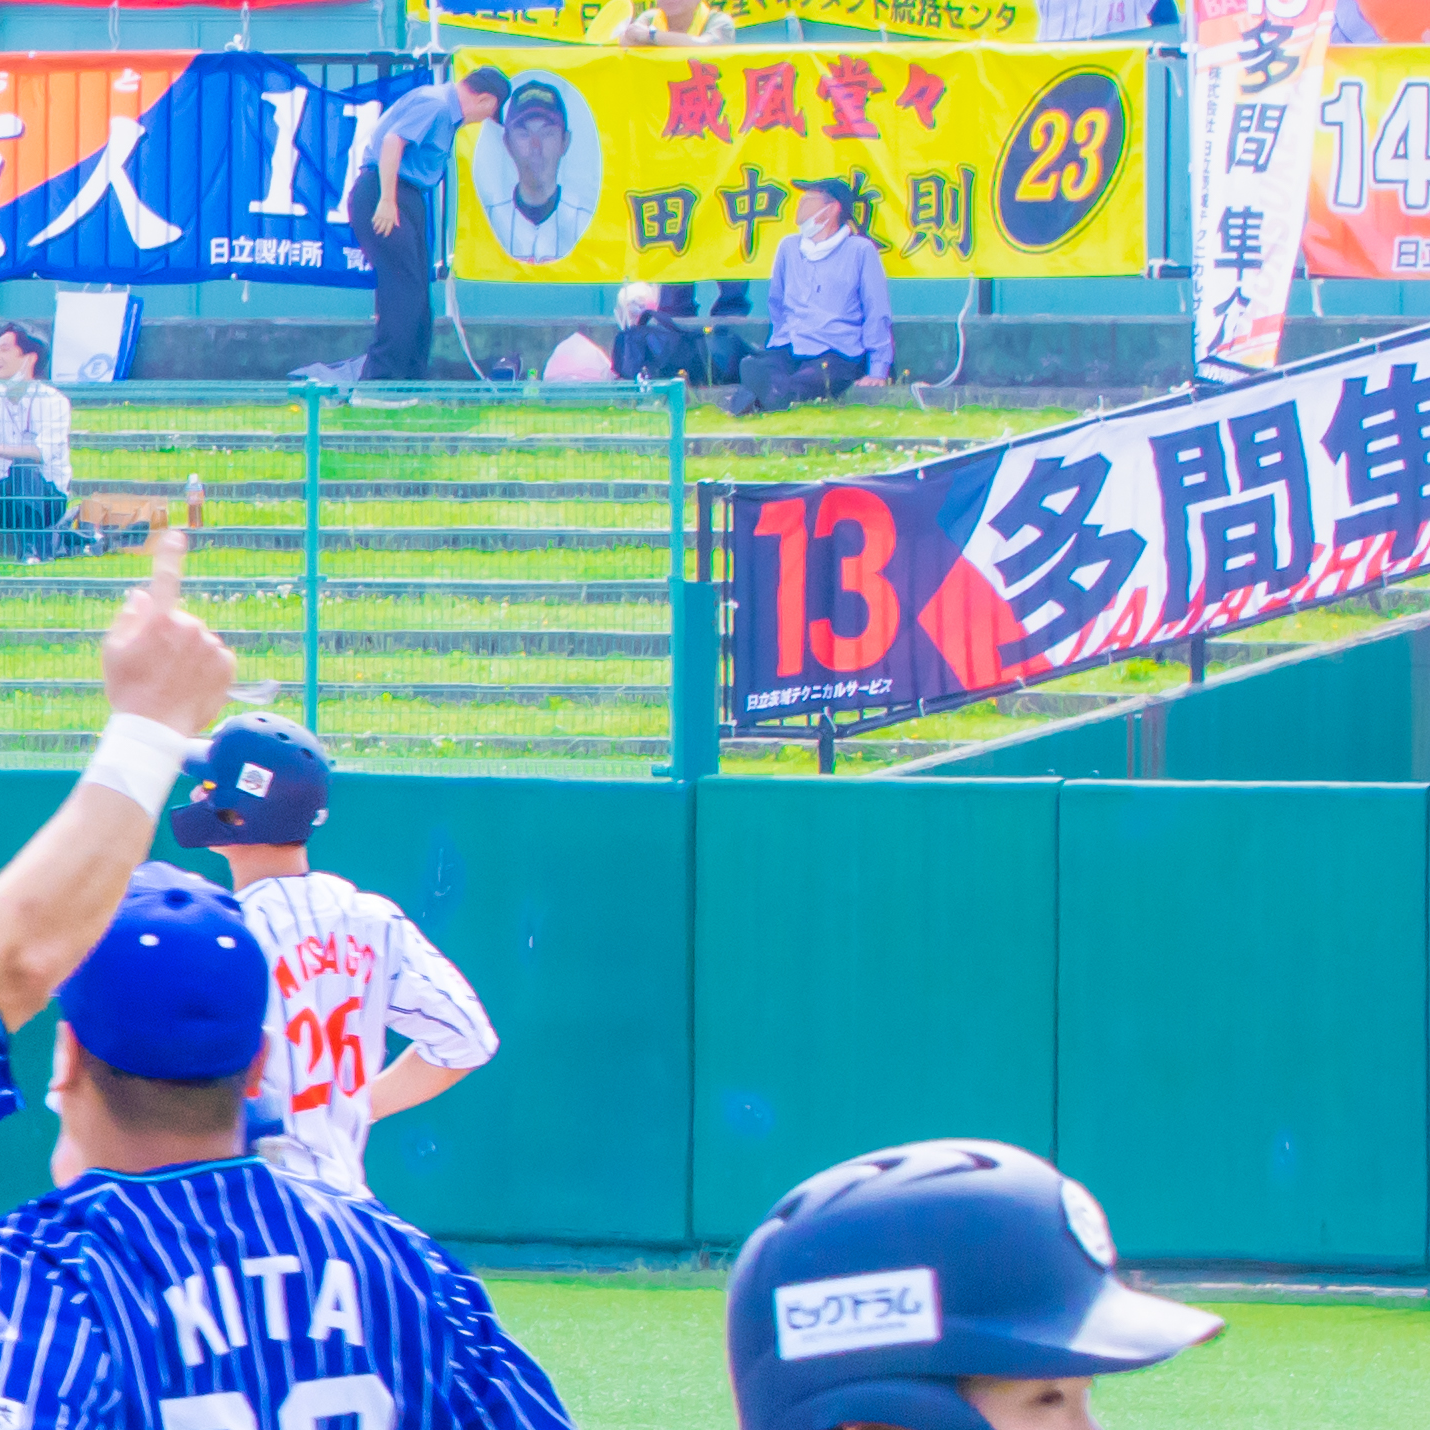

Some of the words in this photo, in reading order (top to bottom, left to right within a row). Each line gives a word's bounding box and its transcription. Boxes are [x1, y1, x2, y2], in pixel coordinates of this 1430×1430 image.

[659, 53, 948, 143] 威風堂々
[1012, 102, 1110, 204] 23
[1225, 20, 1300, 175] 多間
[1320, 80, 1430, 211] 14
[210, 235, 324, 268] 日立製作所
[754, 487, 901, 678] 13
[284, 996, 367, 1115] 26
[162, 1253, 366, 1368] KITA
